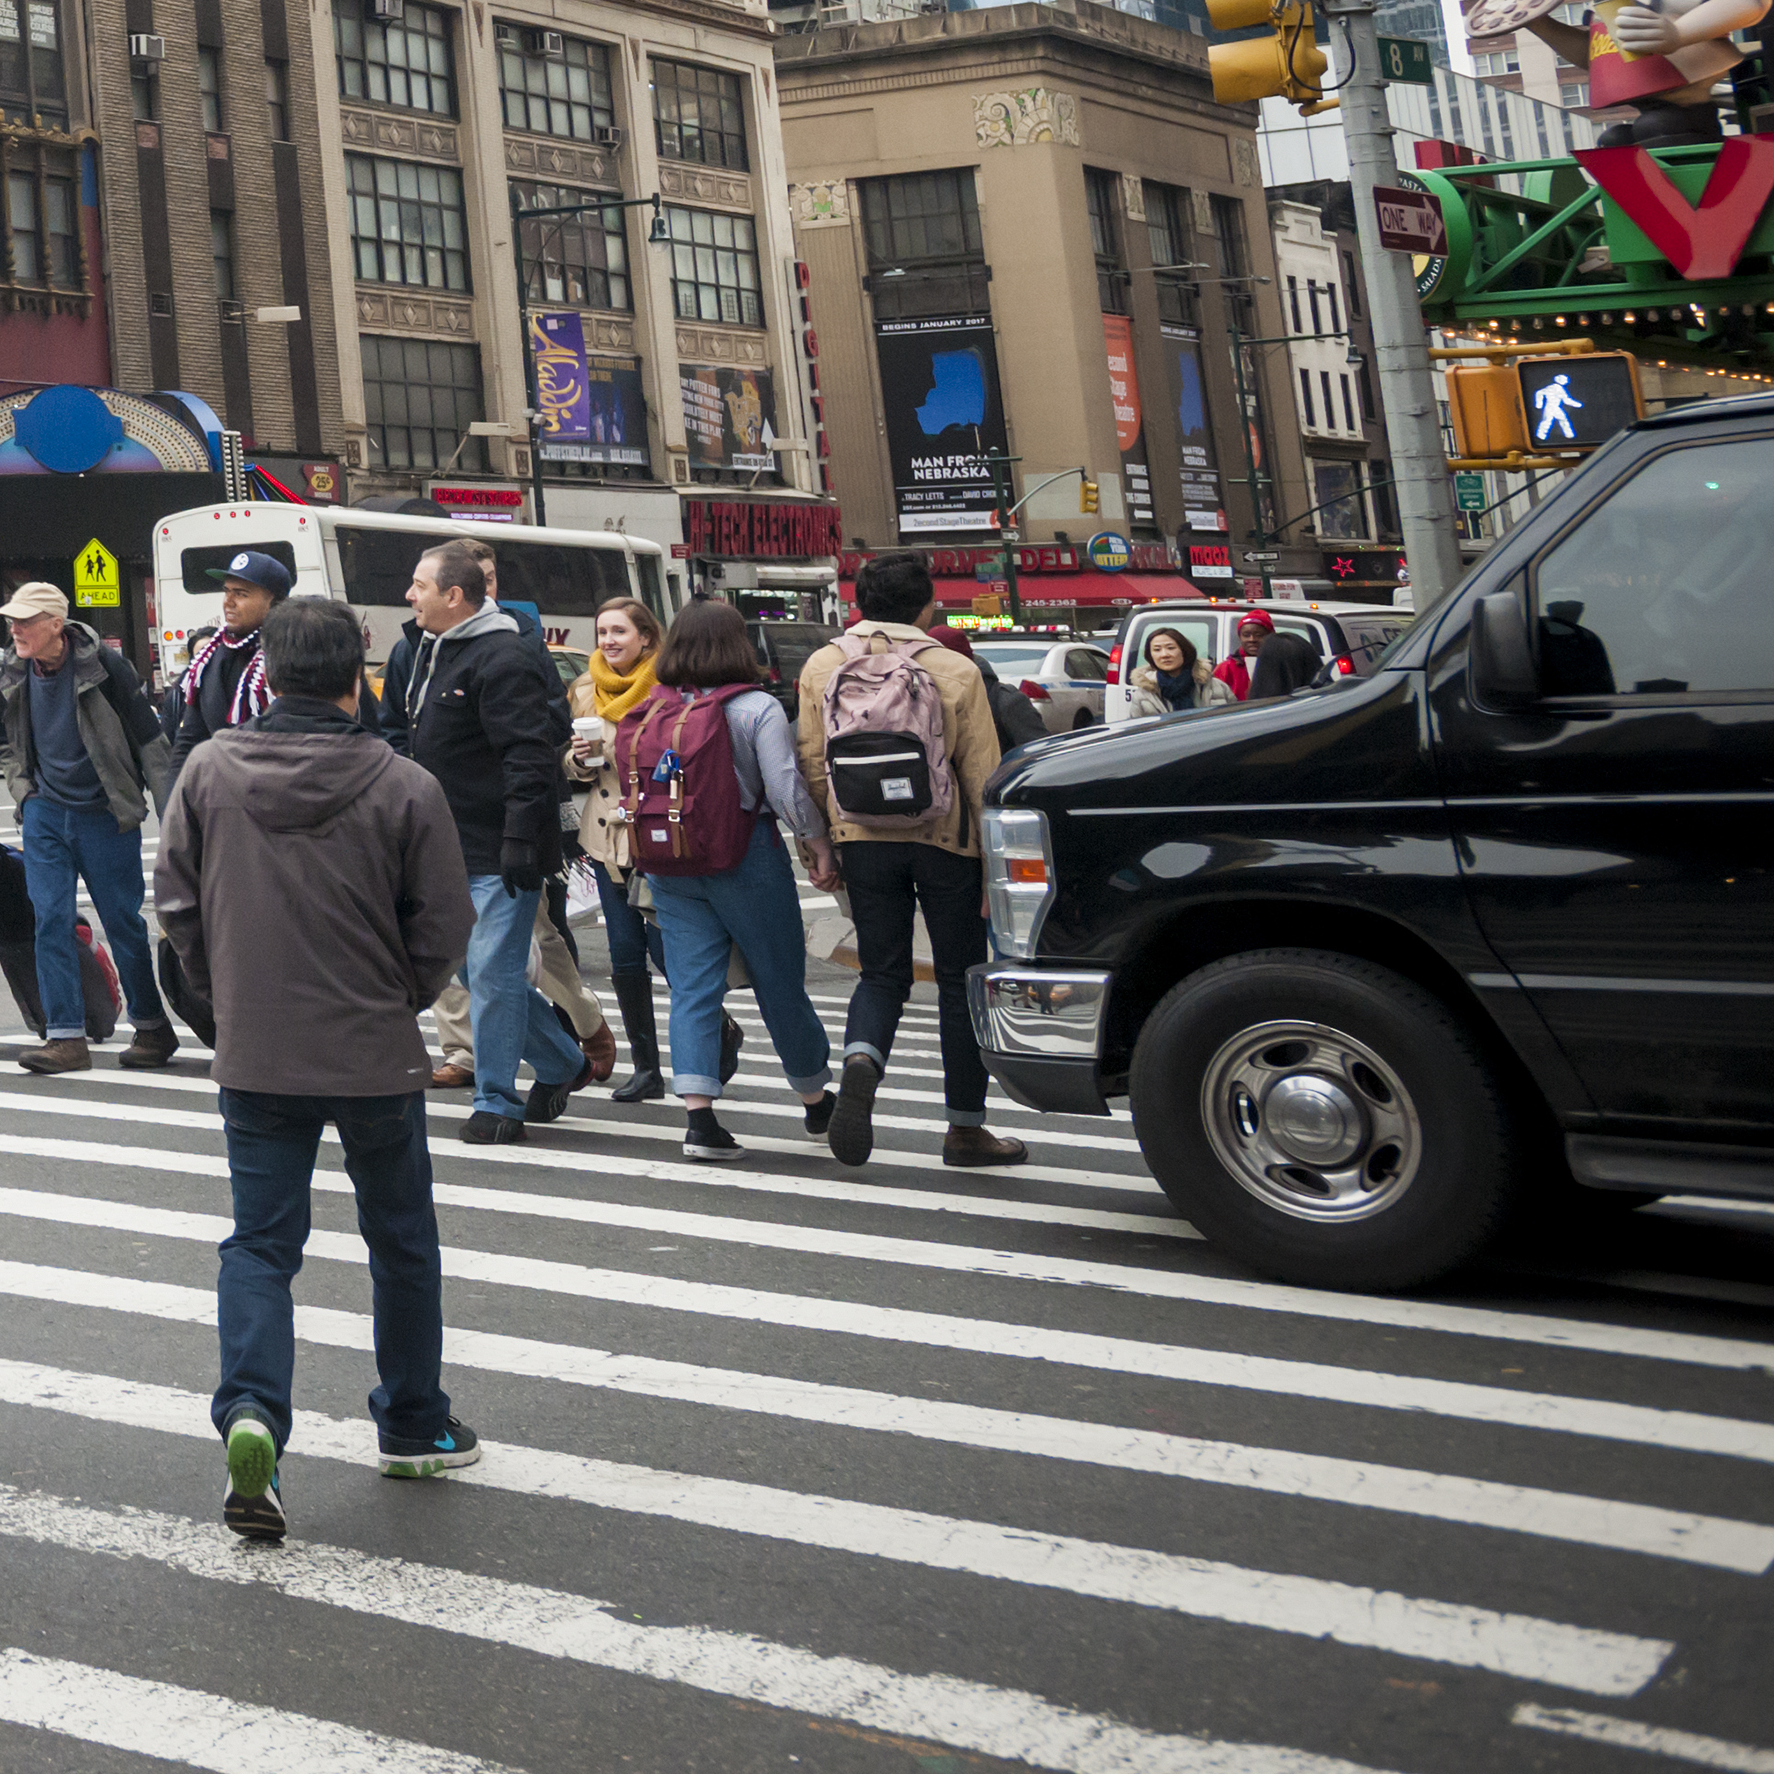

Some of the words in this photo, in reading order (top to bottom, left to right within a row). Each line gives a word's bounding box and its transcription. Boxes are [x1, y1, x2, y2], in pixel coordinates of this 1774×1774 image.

[1388, 42, 1404, 77] 8
[1413, 45, 1424, 62] AV
[1382, 206, 1408, 232] ONE
[1416, 212, 1439, 236] WAY
[1420, 258, 1442, 294] SALADS
[882, 322, 917, 331] BEGINS
[920, 319, 962, 329] JANUARY
[965, 317, 985, 325] 2017
[911, 456, 944, 469] MAN
[913, 467, 990, 480] NEBRASKA
[1020, 547, 1079, 572] DELI
